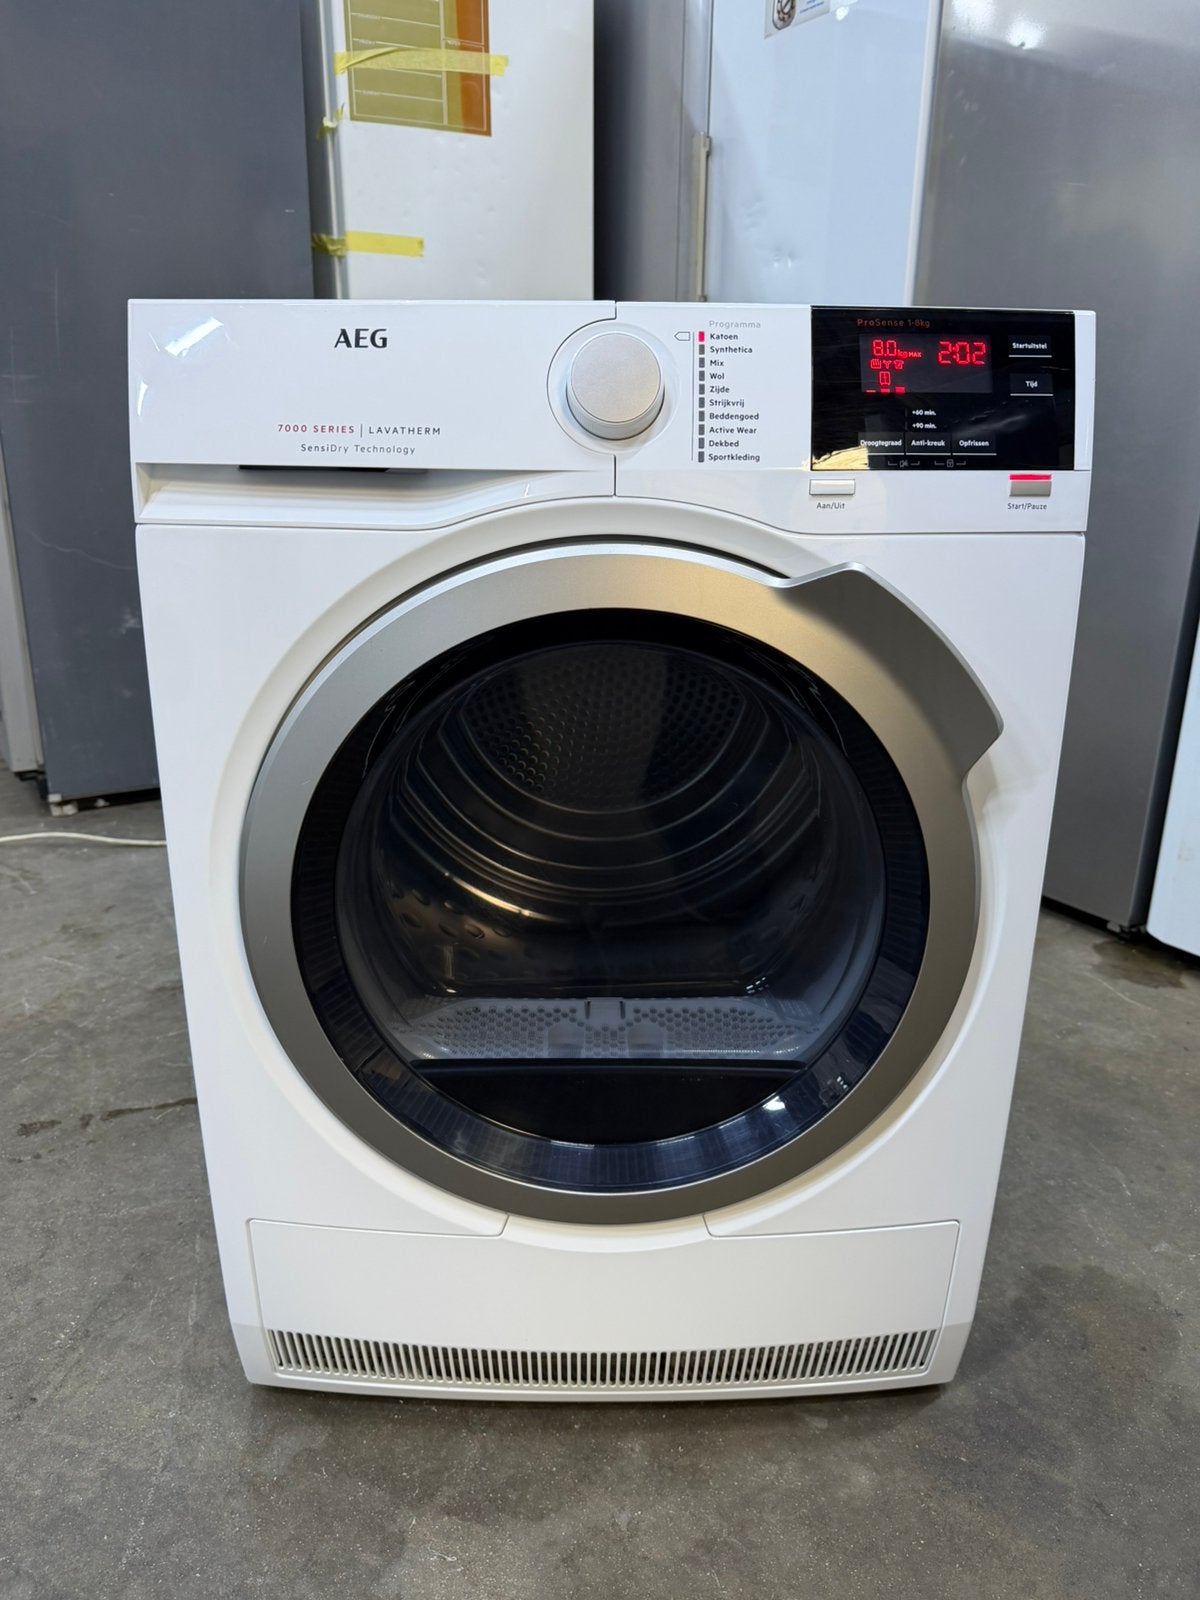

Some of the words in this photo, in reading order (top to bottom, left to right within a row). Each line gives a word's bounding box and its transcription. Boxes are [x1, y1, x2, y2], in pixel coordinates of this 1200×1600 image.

[709, 320, 761, 329] Programma
[857, 318, 904, 327] ProSense
[907, 318, 931, 328] 1-8kg
[334, 328, 388, 349] AEG
[709, 346, 753, 354] Synthetica
[1012, 342, 1048, 350] Startuitstel
[938, 340, 986, 365] 2:02
[1025, 380, 1038, 389] Tijd
[709, 386, 730, 394] Zijde
[709, 399, 745, 408] Strijkvrij
[709, 413, 759, 421] Beddengoed
[278, 424, 308, 433] 7000
[313, 425, 355, 433] SERIES
[368, 426, 441, 435] LAVATHERM
[860, 439, 902, 448] Droogtegraad
[911, 439, 945, 447] Anti-kreuk
[959, 439, 989, 448] Opfrissen
[300, 443, 349, 454] SensiDry
[354, 445, 416, 456] Technology
[708, 454, 760, 462] Sportkleding
[816, 502, 845, 511] Aan/Uit
[1007, 502, 1048, 511] Start/Pauze
